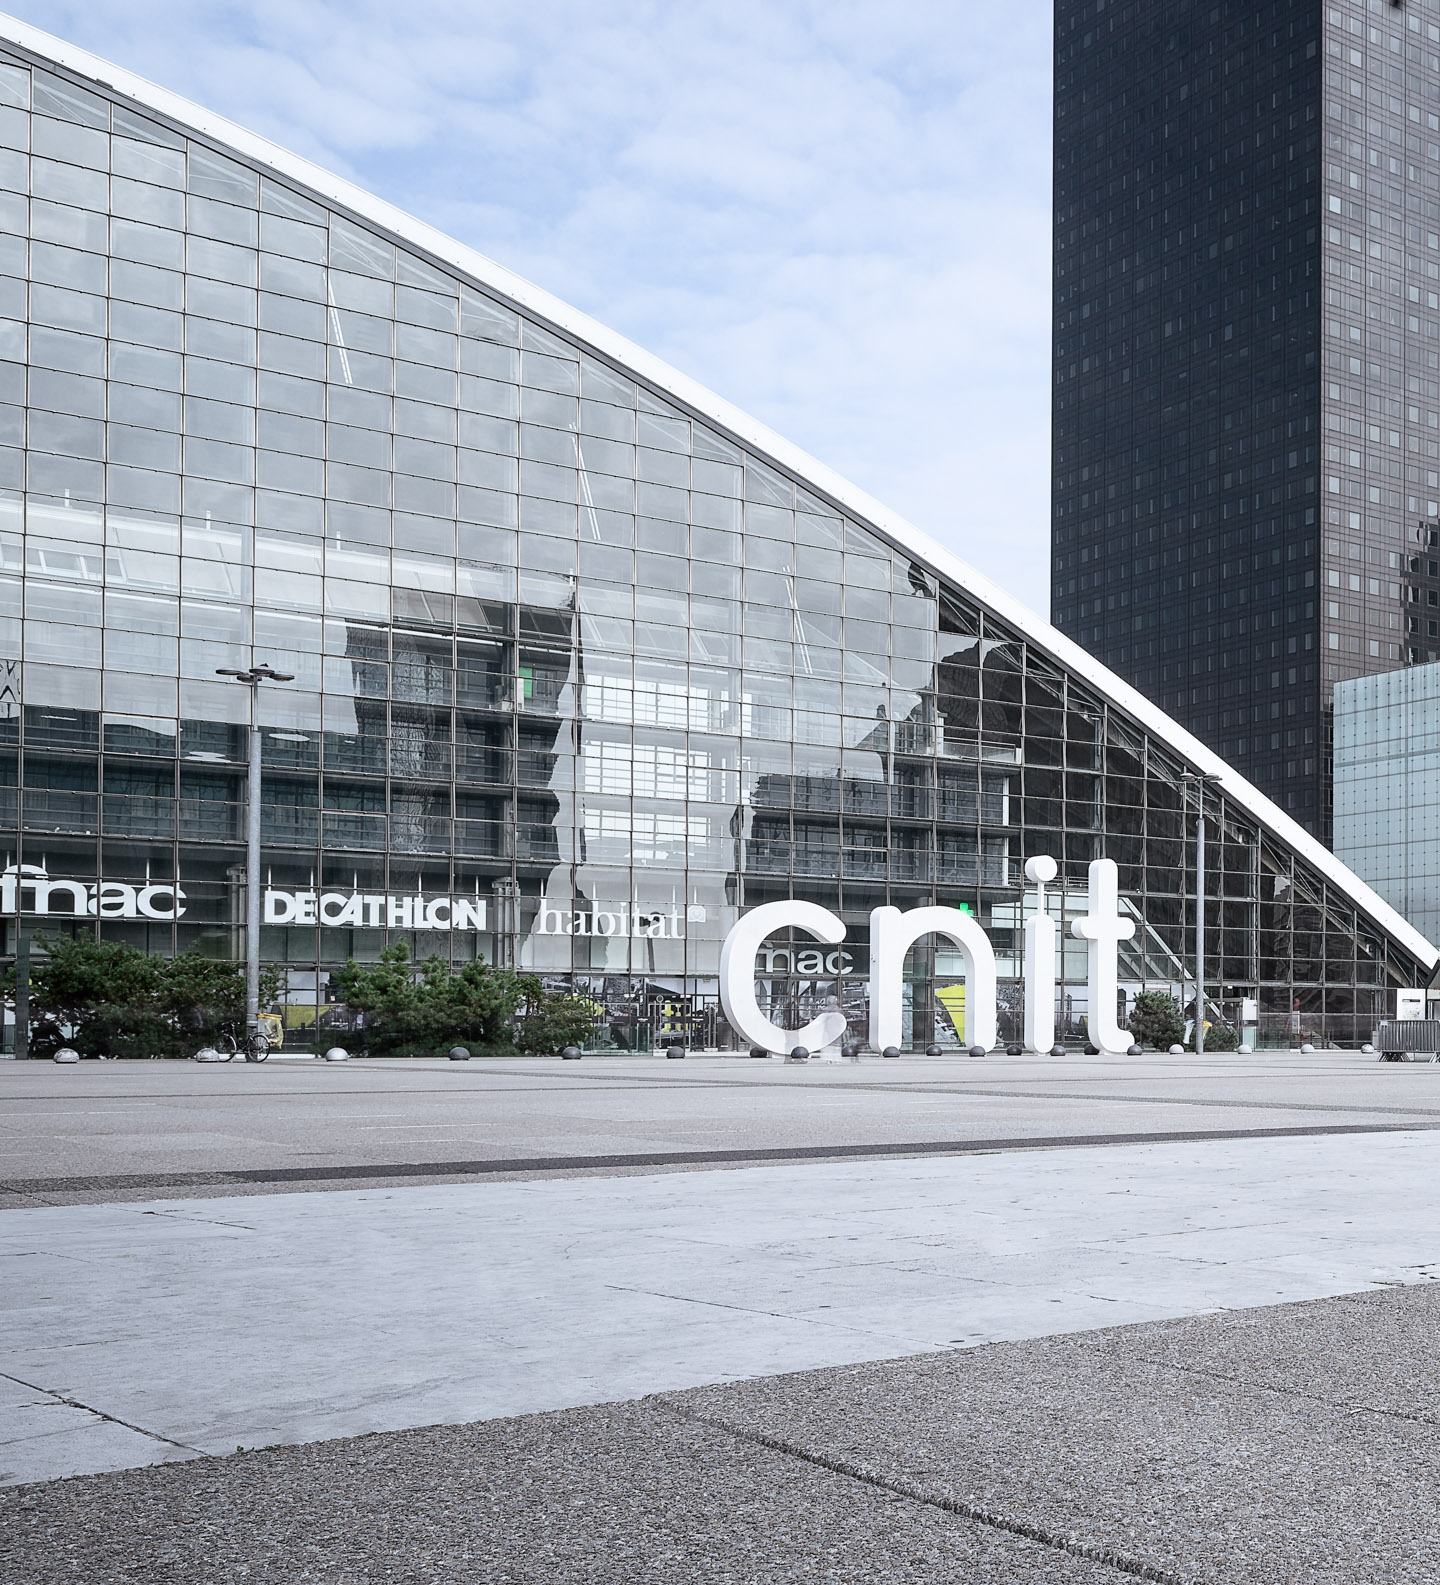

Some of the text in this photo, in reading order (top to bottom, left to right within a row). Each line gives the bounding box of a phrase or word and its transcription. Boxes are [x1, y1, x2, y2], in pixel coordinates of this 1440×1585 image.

[0, 864, 187, 920] fnac
[264, 890, 487, 931] DECATHLON
[536, 898, 684, 939] habitat
[720, 855, 1136, 1056] cnit
